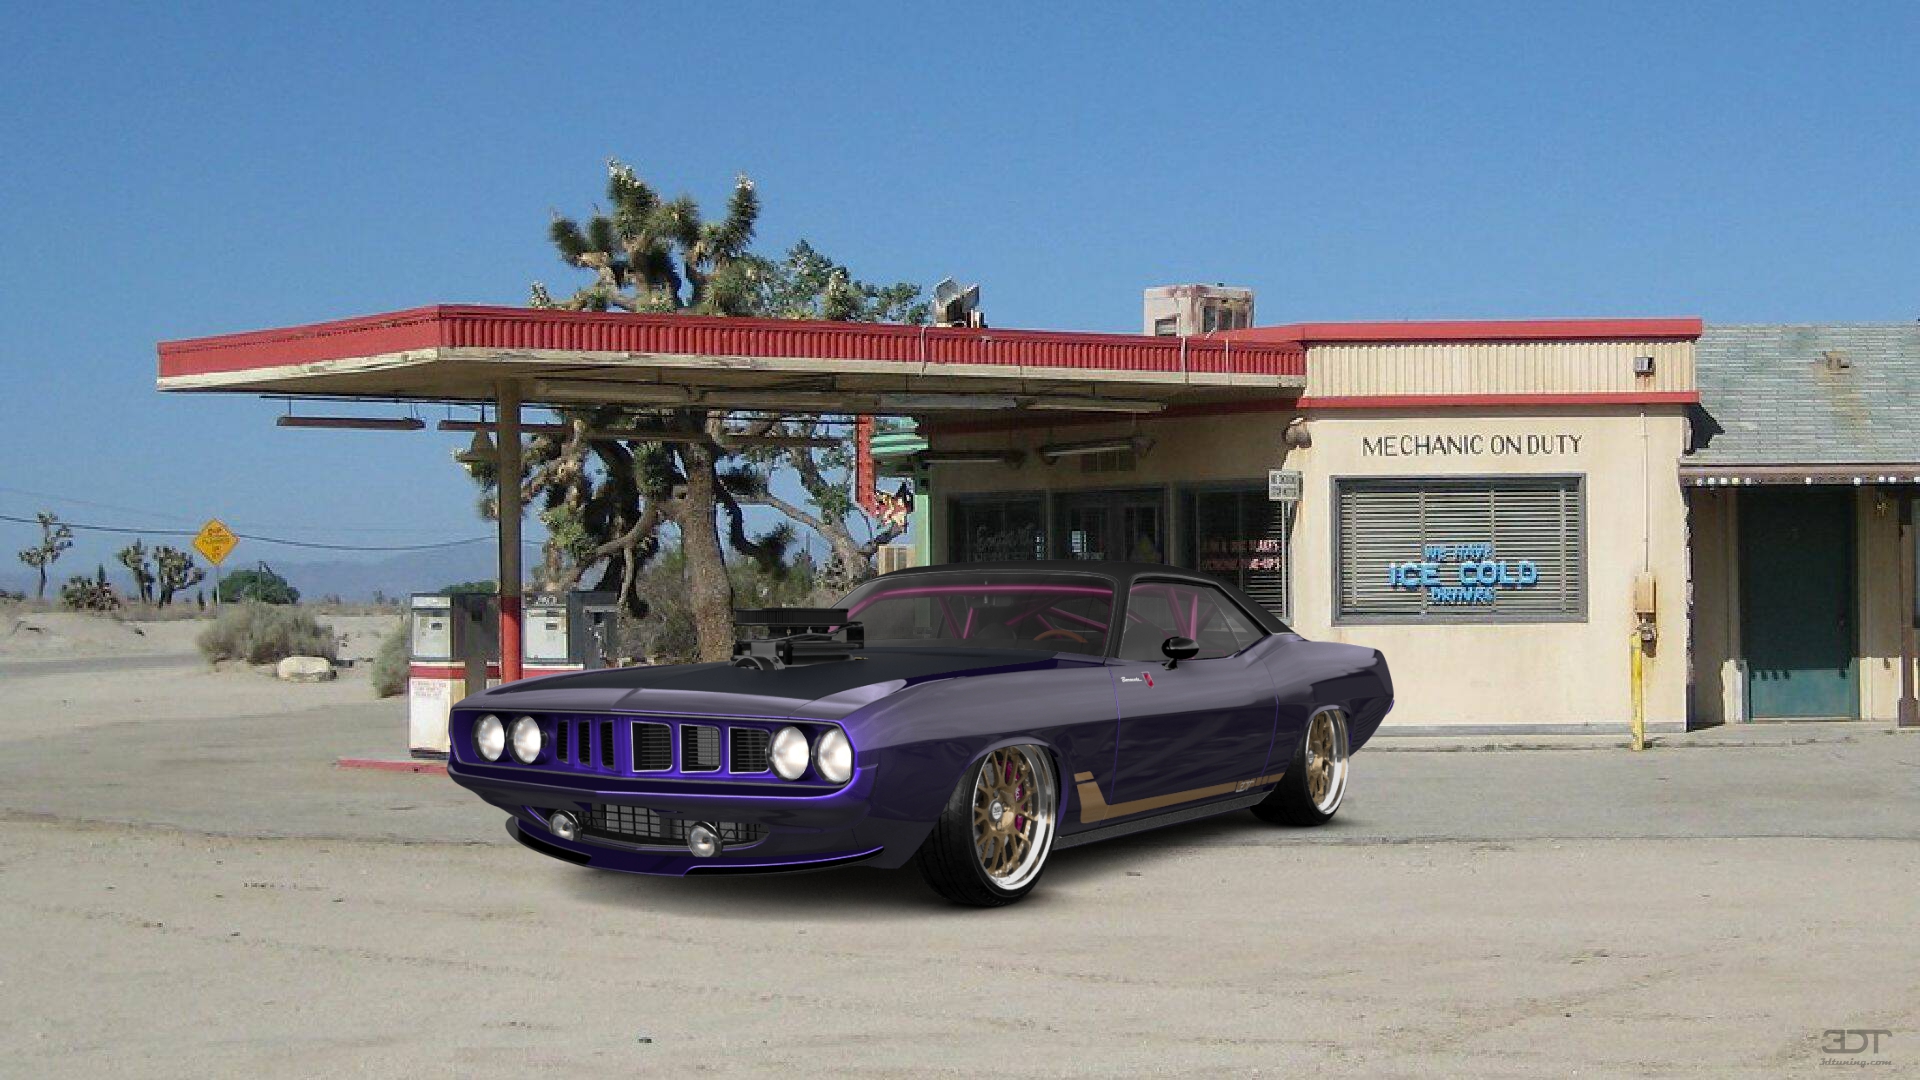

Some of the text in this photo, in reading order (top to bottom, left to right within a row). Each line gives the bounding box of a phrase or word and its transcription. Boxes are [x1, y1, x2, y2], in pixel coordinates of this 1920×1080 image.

[1362, 434, 1583, 457] MECHANIC ON DUTY
[1389, 560, 1538, 588] ICE COLD
